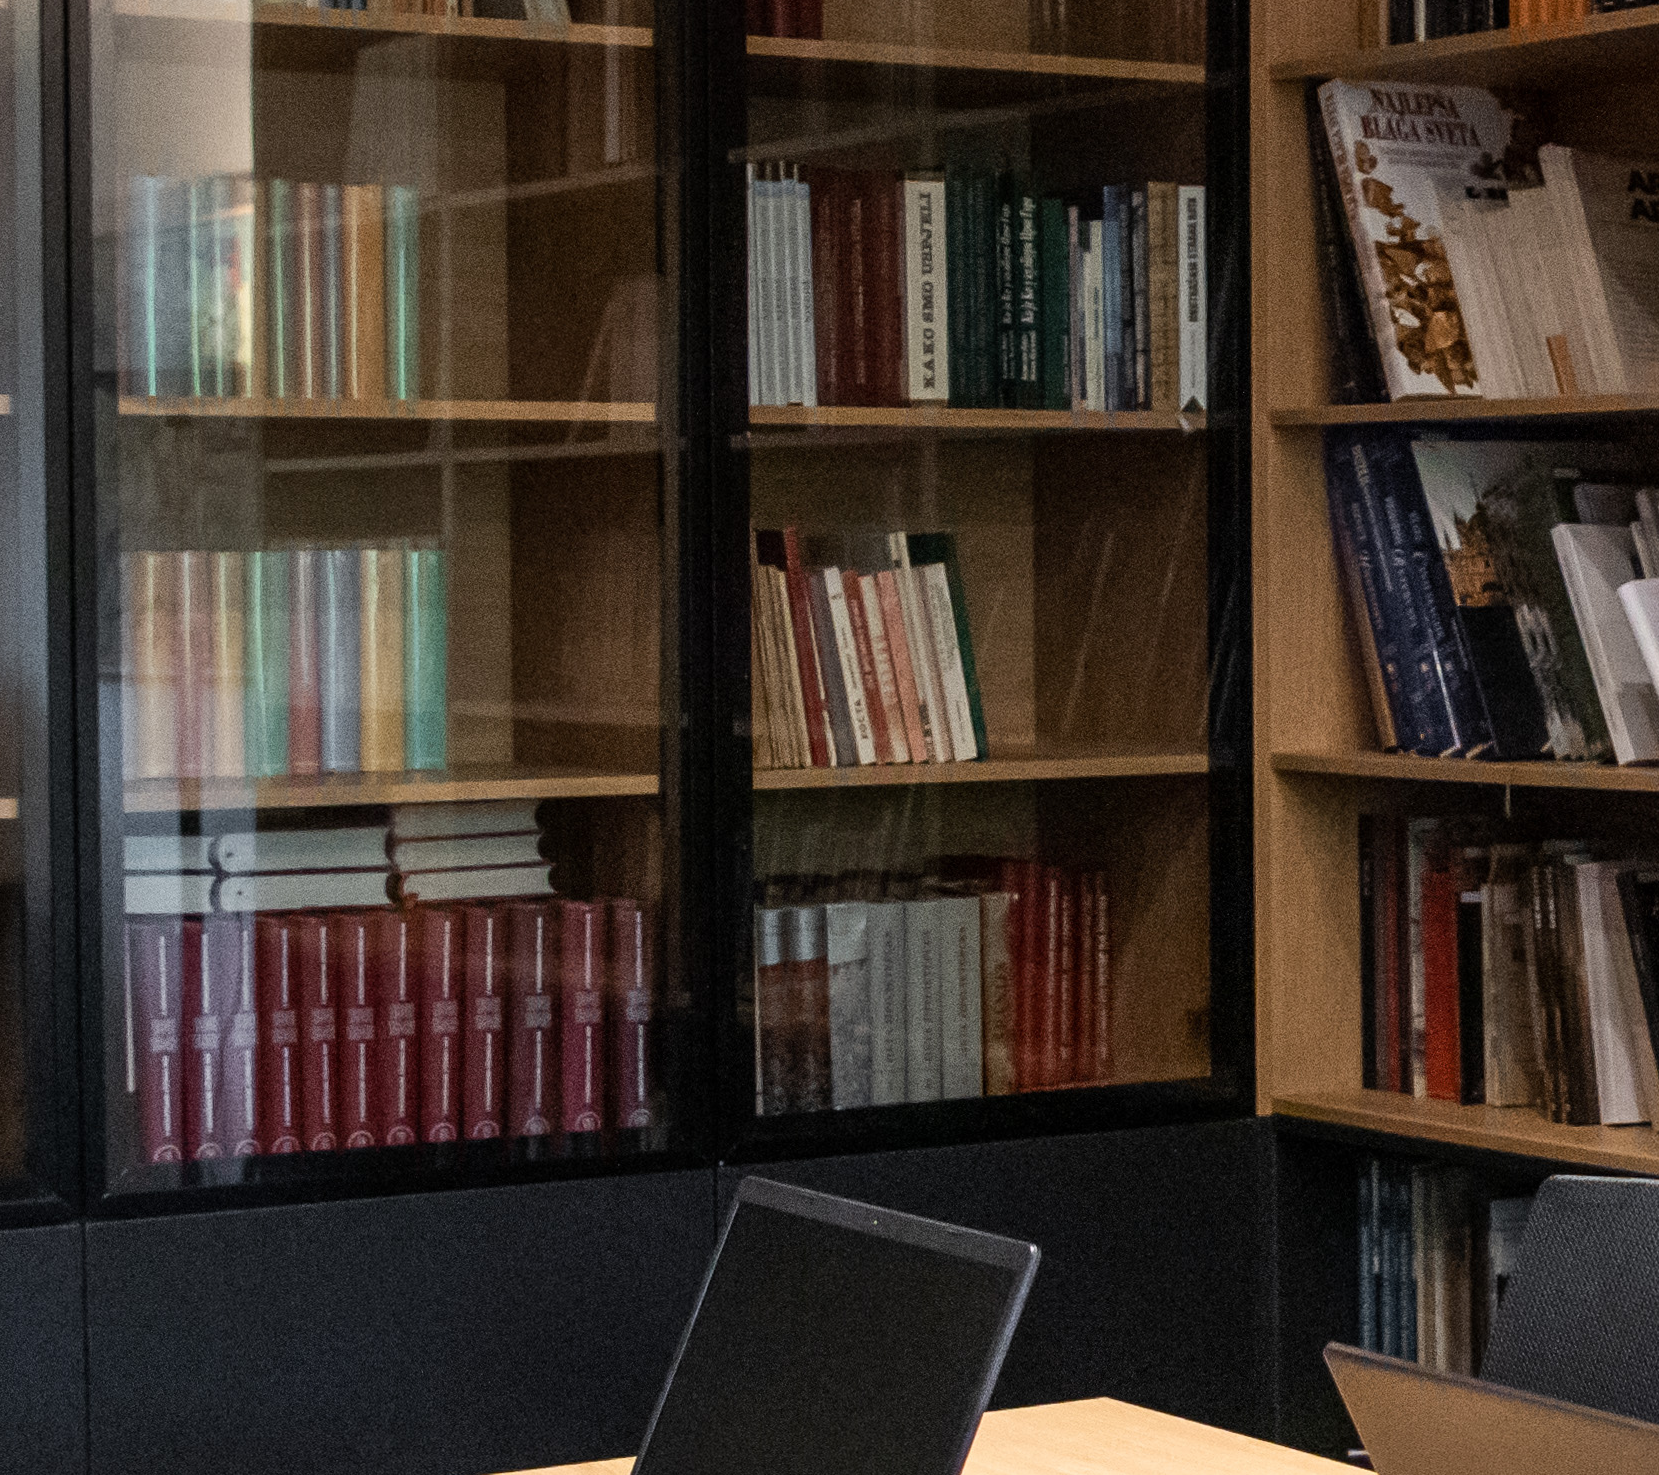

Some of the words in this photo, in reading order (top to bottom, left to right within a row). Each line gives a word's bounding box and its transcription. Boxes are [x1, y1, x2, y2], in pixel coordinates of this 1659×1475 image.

[1360, 115, 1422, 143] BLAGA
[1423, 121, 1483, 147] SVETA
[920, 280, 935, 324] SMO
[920, 328, 935, 390] KAKO
